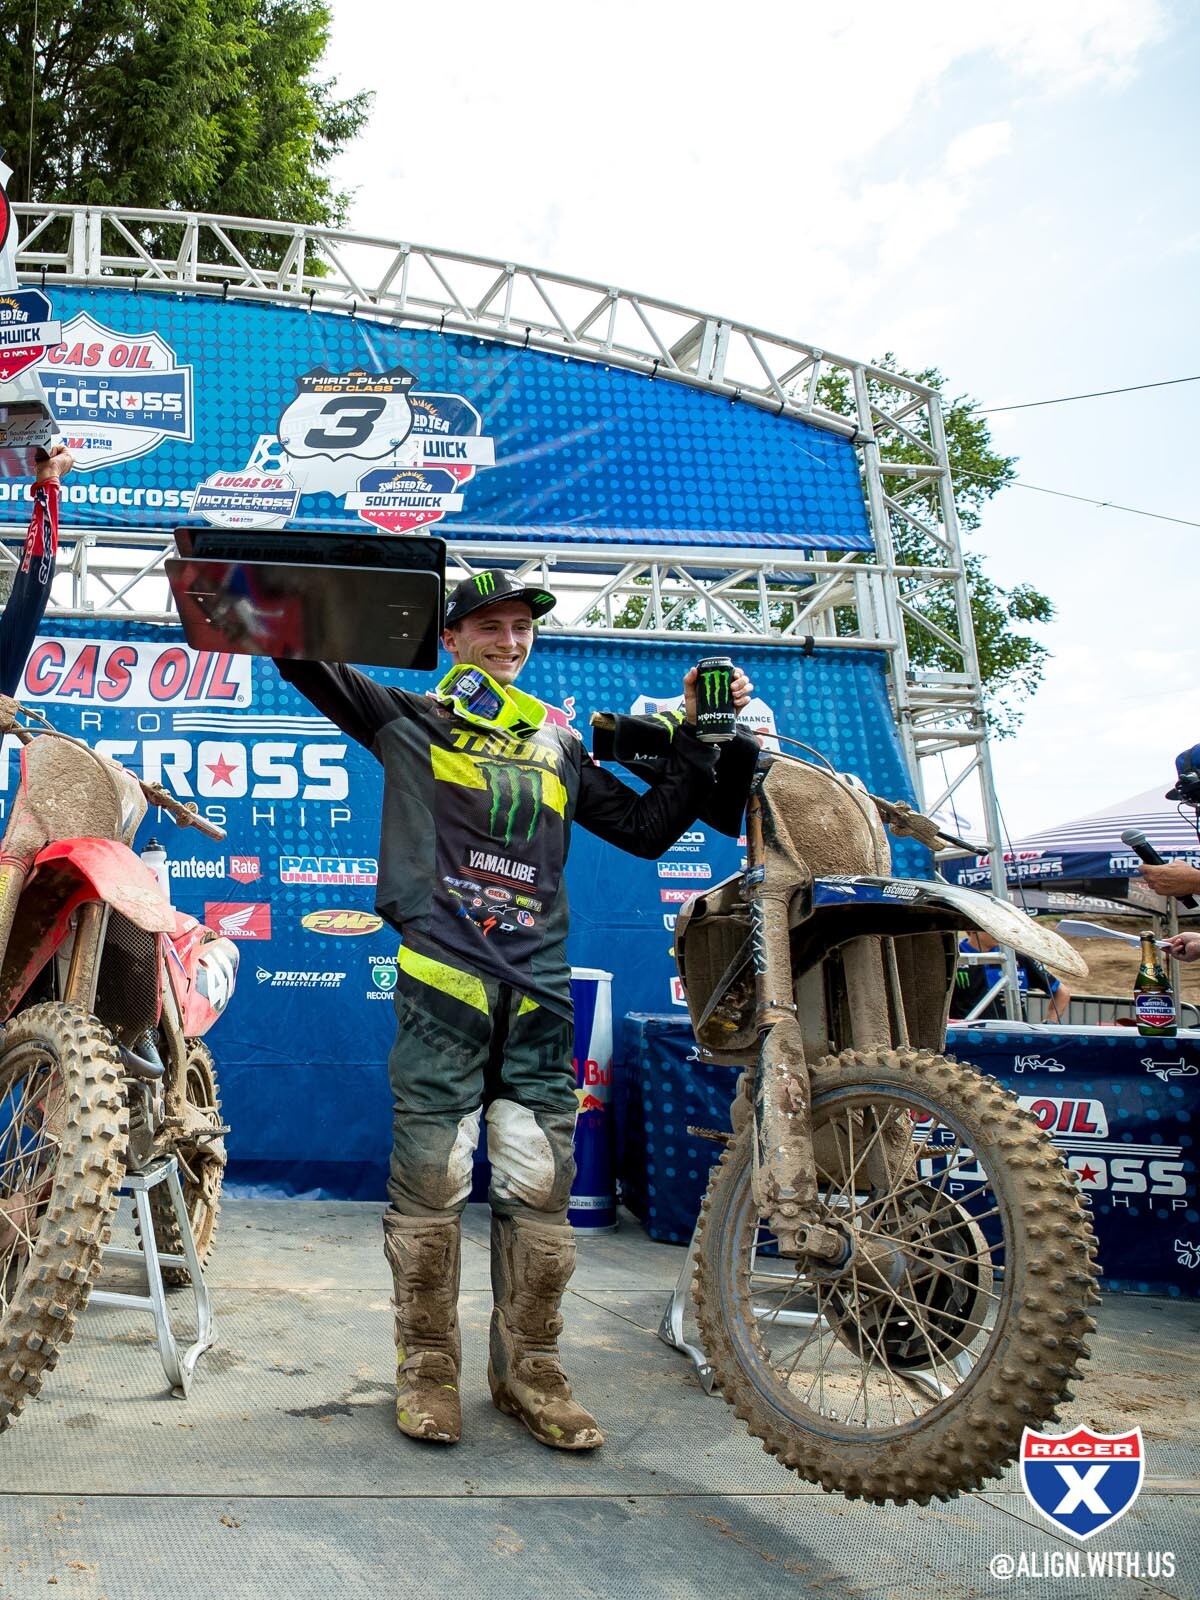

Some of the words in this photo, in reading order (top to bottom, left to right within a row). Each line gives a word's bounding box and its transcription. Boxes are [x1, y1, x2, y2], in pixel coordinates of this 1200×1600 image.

[12, 309, 29, 323] TEA
[48, 343, 103, 367] CAS
[109, 344, 153, 369] OIL
[57, 378, 109, 389] PRO
[302, 377, 350, 385] THIRD
[356, 377, 412, 385] PLACE
[46, 386, 182, 412] TOCROSS
[58, 407, 183, 420] PIONSHIP
[303, 396, 387, 449] 3
[60, 437, 92, 449] AMA
[93, 439, 113, 447] PRO
[214, 477, 261, 489] LUCAS
[261, 478, 284, 489] OIL
[379, 480, 416, 492] TWISTED
[416, 480, 433, 493] TEA
[196, 494, 294, 507] MOTOCROSS
[365, 496, 442, 508] SOUTHWICK
[148, 645, 240, 701] OIL
[736, 715, 772, 724] RMANCE
[450, 728, 558, 769] THOR
[165, 855, 225, 879] ranteed
[231, 859, 259, 875] Rate
[281, 857, 378, 874] PARTS
[469, 849, 537, 883] YAMALUBE
[658, 863, 710, 872] PARTS
[281, 873, 378, 885] UNLIMITED
[883, 885, 920, 897] ESCONDIDO
[302, 913, 383, 929] FMF
[219, 929, 257, 937] HONDA
[368, 956, 398, 965] ROAD
[272, 971, 346, 982] DUNLOP
[379, 972, 391, 986] 2
[366, 991, 394, 1000] RECOVE
[1034, 1100, 1098, 1133] OIL
